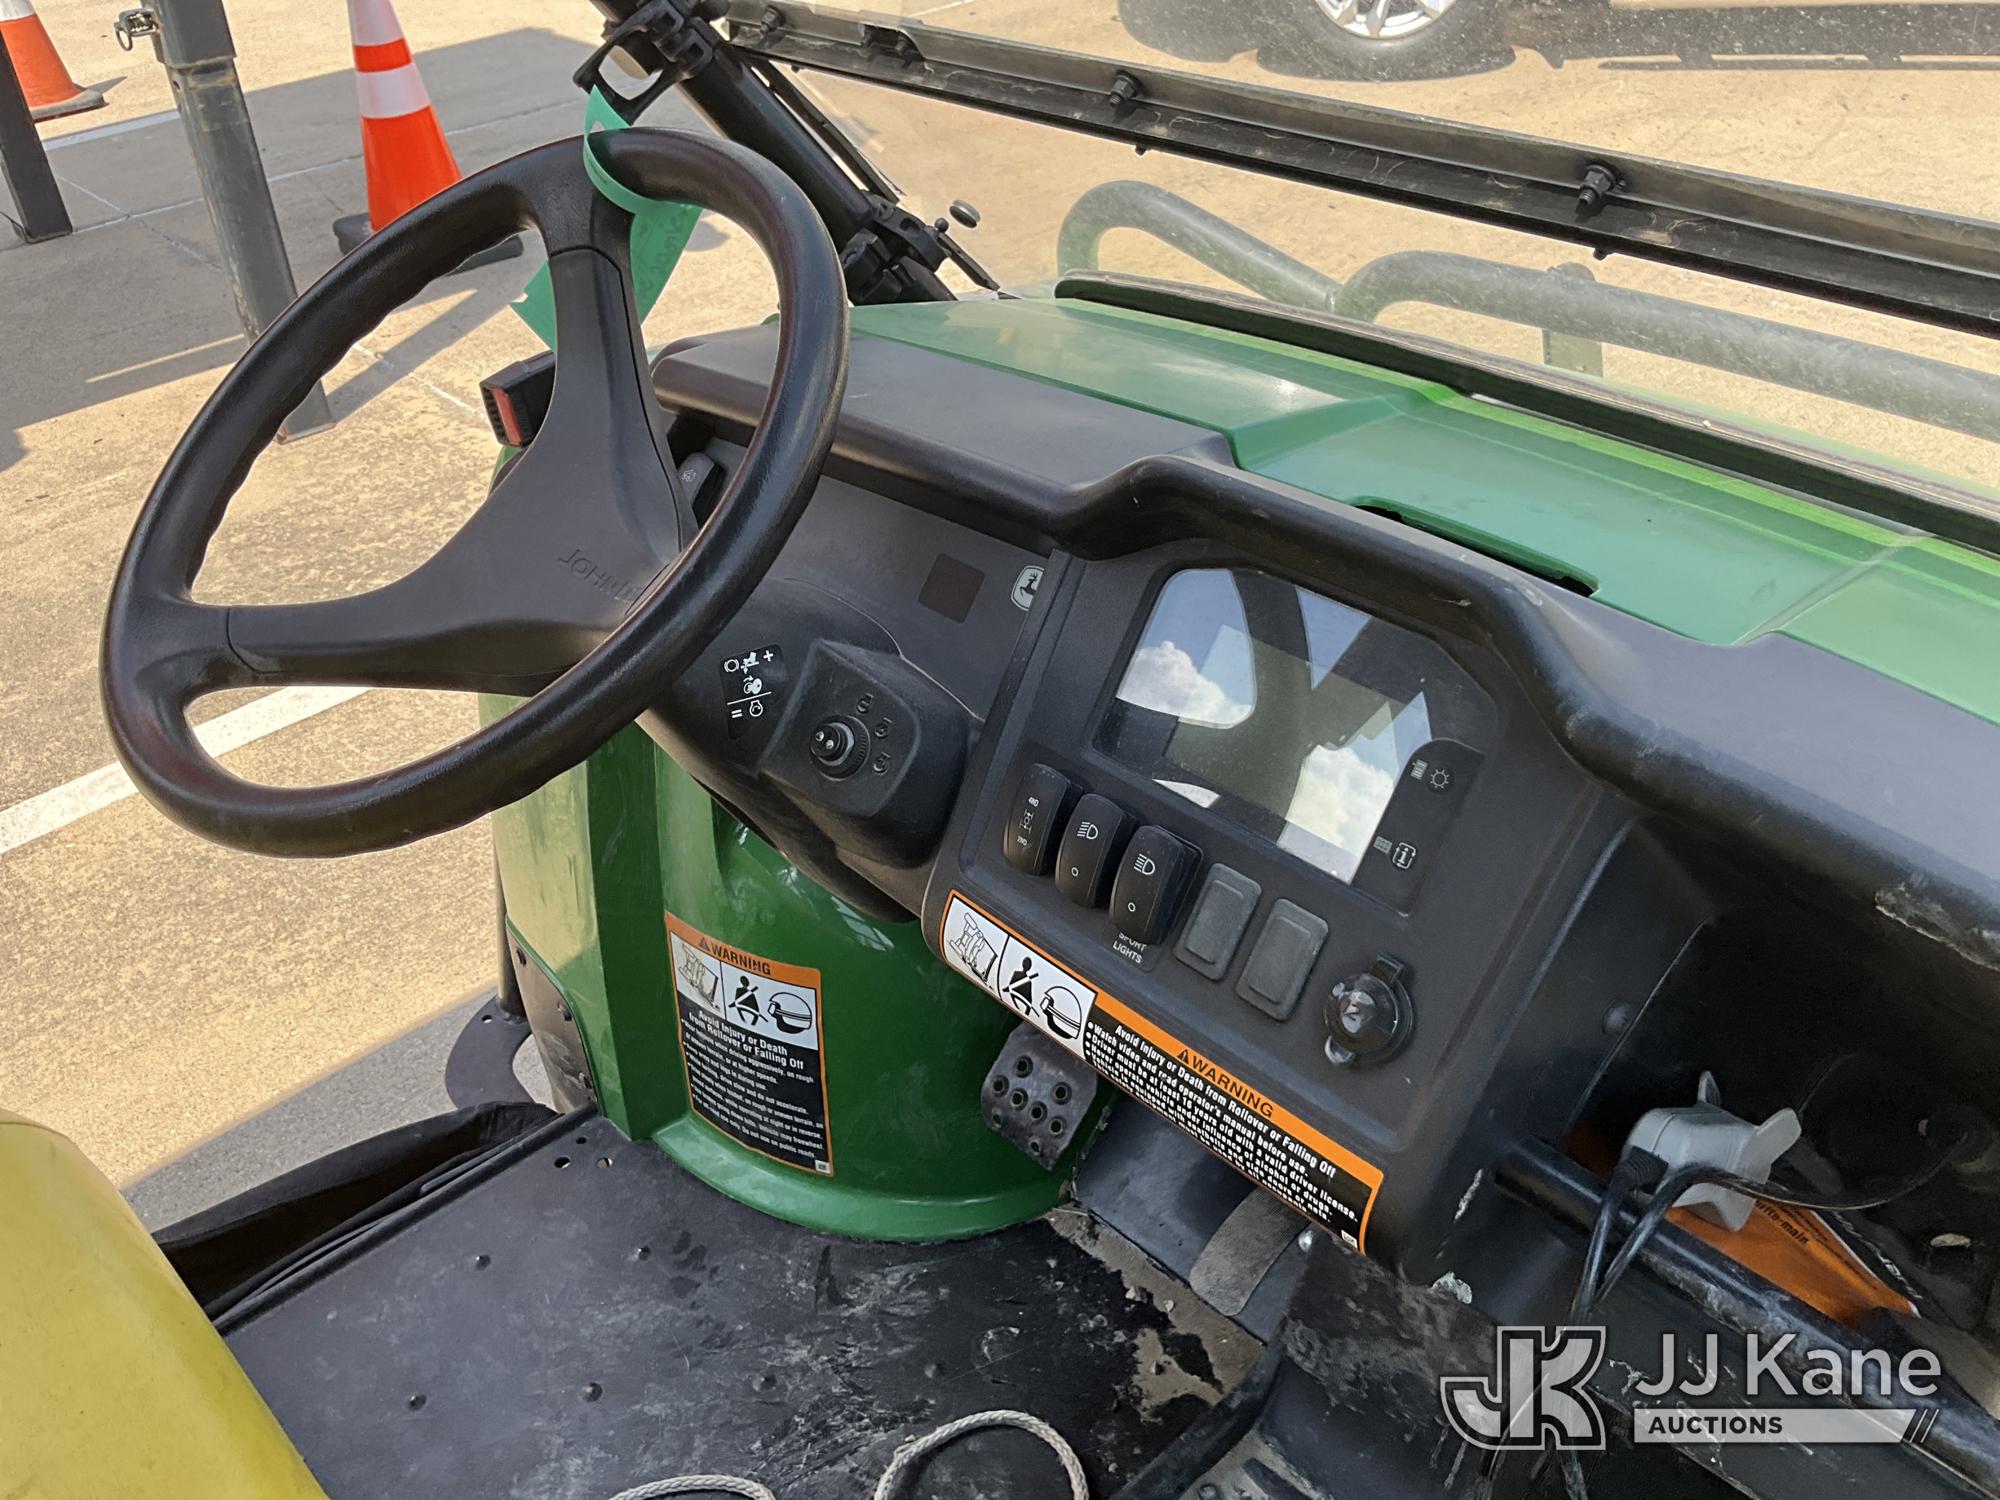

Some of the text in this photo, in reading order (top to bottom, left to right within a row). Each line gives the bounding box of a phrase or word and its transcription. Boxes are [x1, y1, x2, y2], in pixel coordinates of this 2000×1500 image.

[711, 943, 771, 976] WARNING
[1112, 940, 1143, 964] LIGHTS
[688, 1011, 804, 1070] from Rollover or Falling Off
[698, 1009, 788, 1056] Avoid Injury or Death
[1093, 1023, 1309, 1176] Watch video and read operator's manual before use.
[1115, 1024, 1335, 1178] Avoid Injury or Death from Rollover or Falling Off
[1193, 1055, 1274, 1119] WARNING
[1091, 1033, 1359, 1223] Driver must be at least 16 years old with a valid driver license.
[1091, 1043, 1333, 1216] Never operate vehicle under influence of alcohol or drugs.
